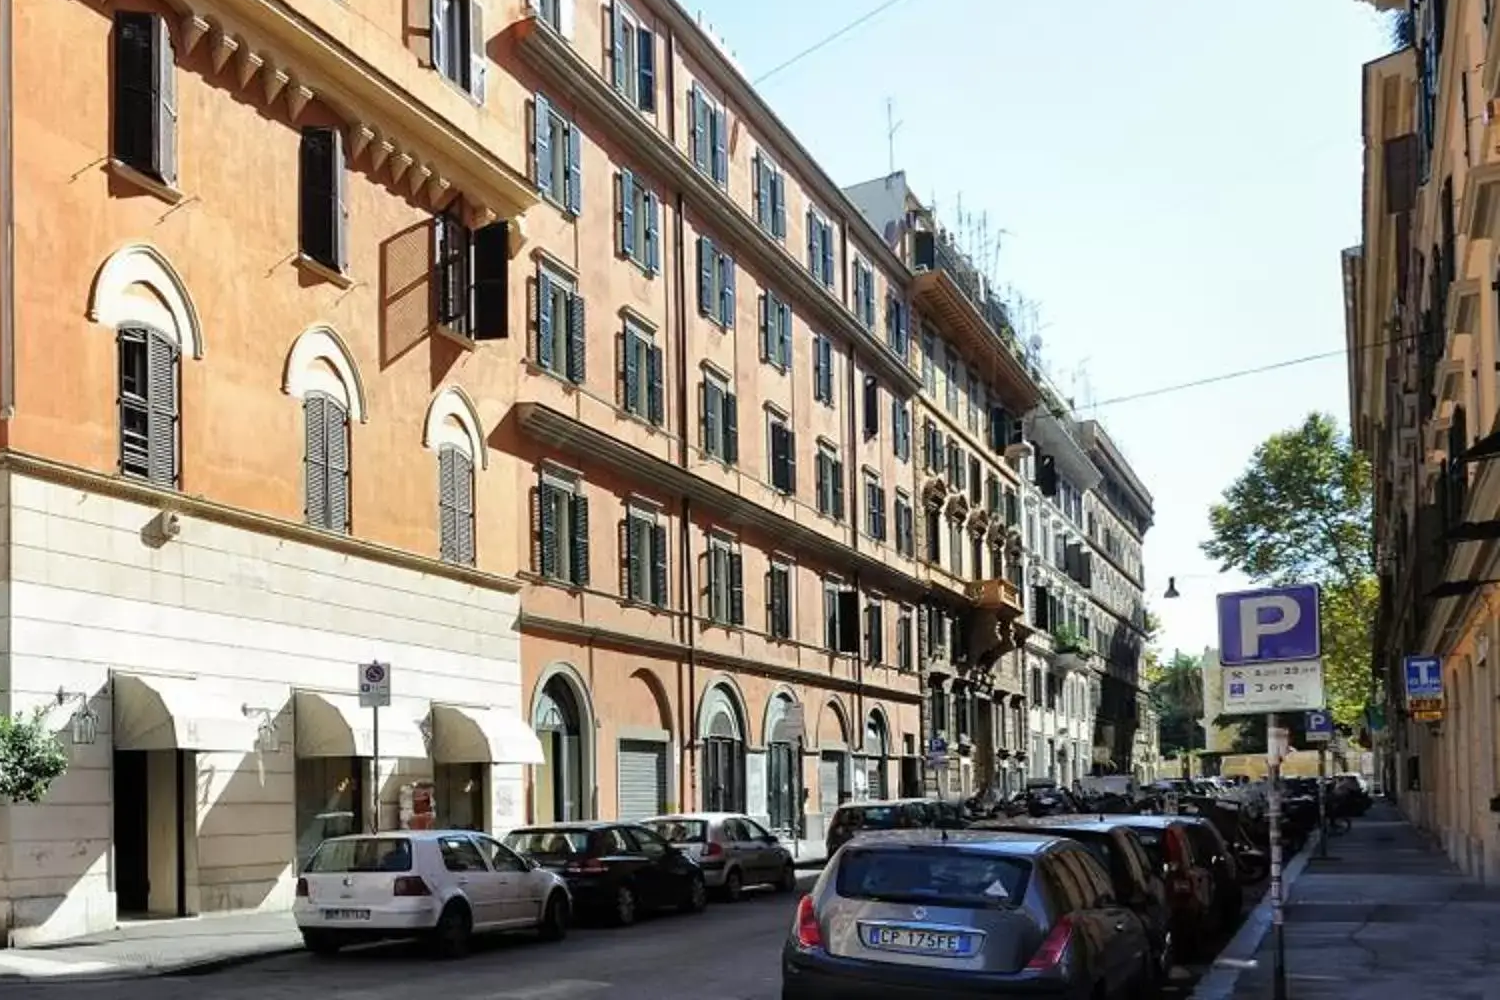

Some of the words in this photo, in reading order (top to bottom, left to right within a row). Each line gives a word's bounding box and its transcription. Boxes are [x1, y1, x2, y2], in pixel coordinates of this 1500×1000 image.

[1240, 595, 1301, 657] P
[1411, 661, 1437, 685] T
[1310, 714, 1325, 730] P
